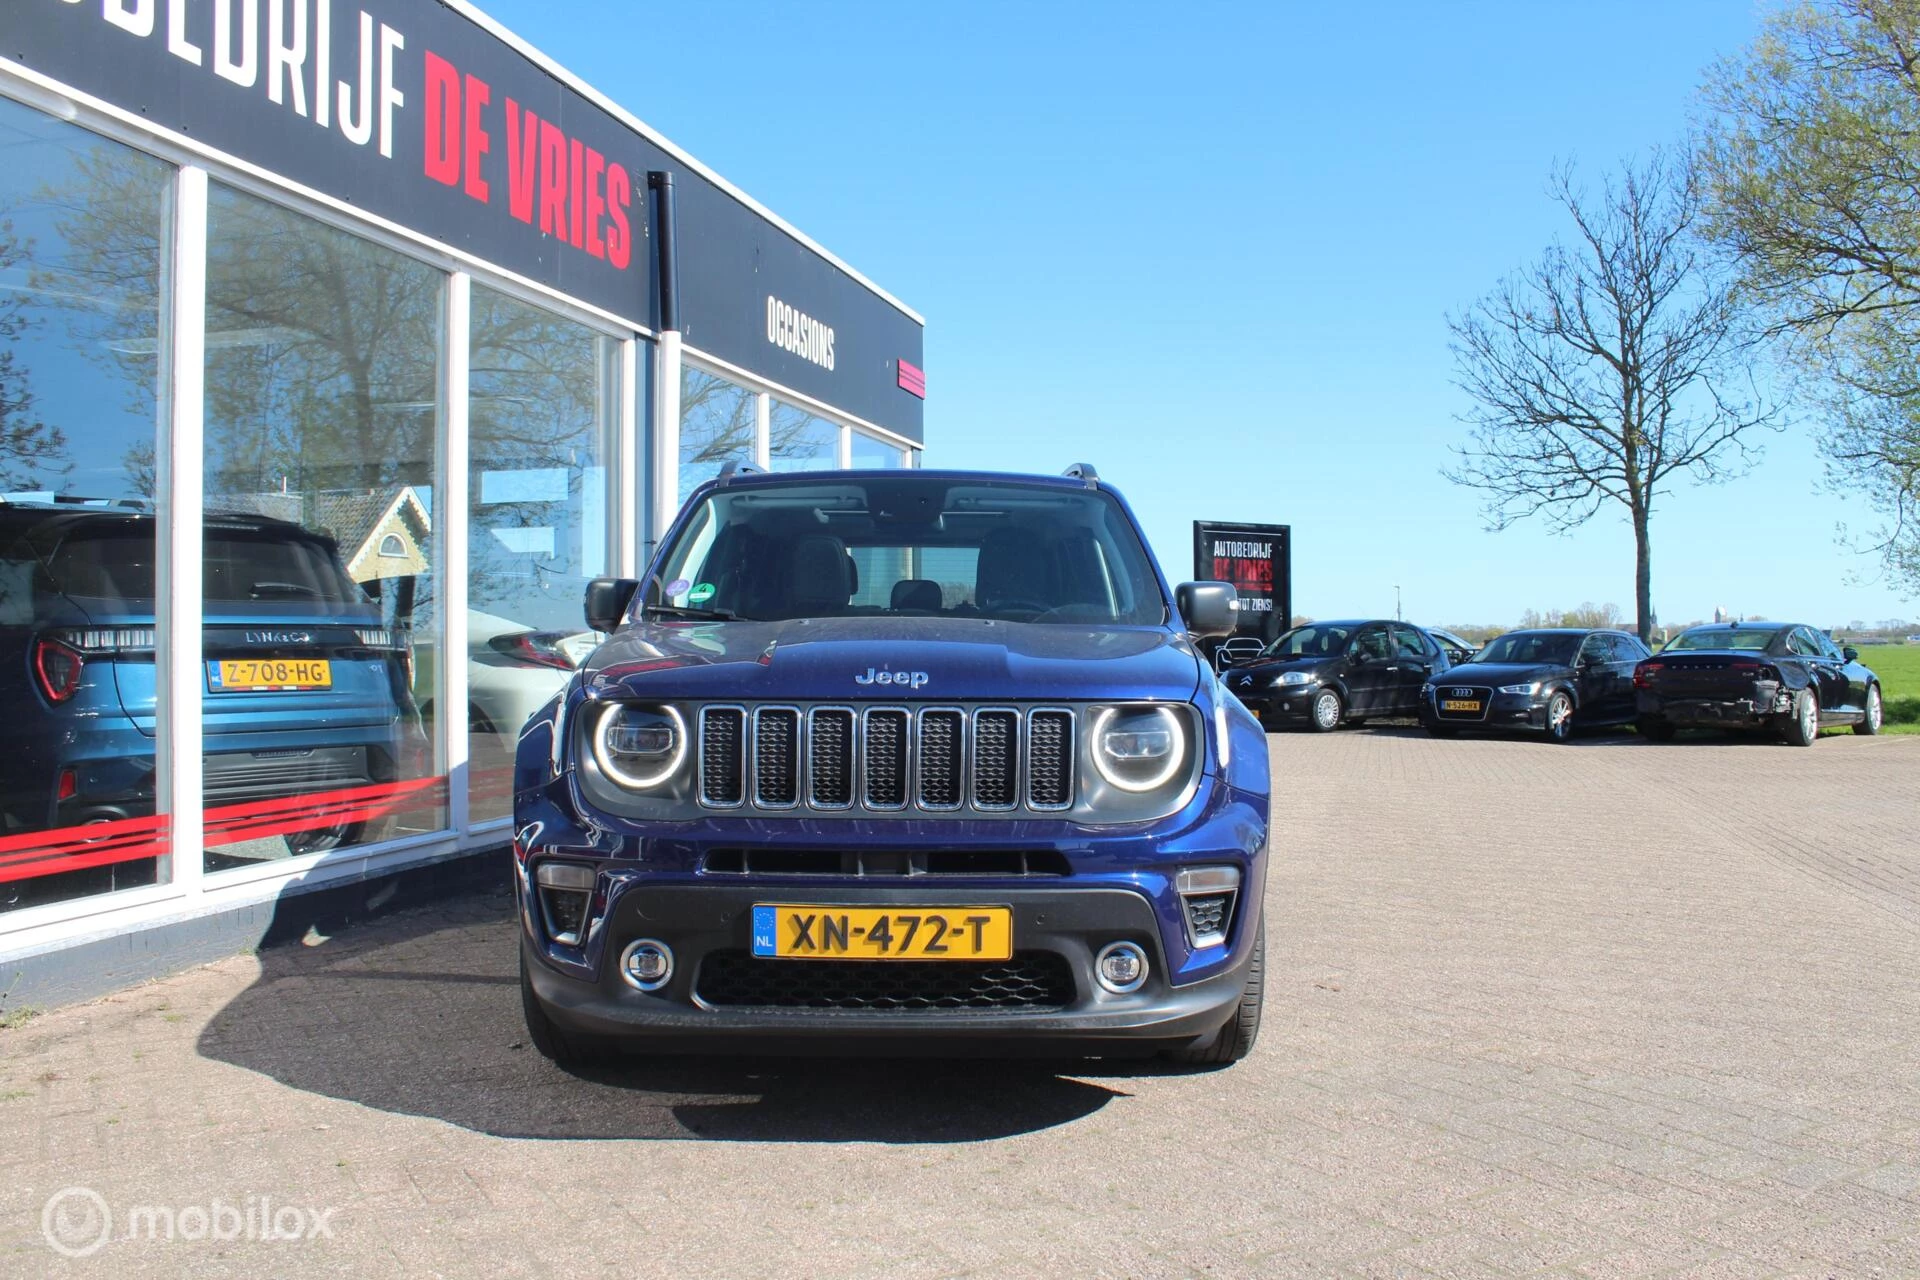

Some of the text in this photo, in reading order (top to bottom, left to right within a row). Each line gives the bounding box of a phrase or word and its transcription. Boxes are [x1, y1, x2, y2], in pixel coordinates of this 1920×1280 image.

[425, 51, 489, 203] DE
[505, 97, 631, 269] VRIES
[767, 295, 834, 371] OCCASIONS
[1213, 540, 1273, 559] AUTOBEDRIJF
[1252, 598, 1273, 611] ZIENS!
[227, 663, 323, 683] Z-708-HG
[855, 667, 929, 689] Jeep
[756, 936, 773, 947] NL
[791, 913, 991, 952] XN-472-T
